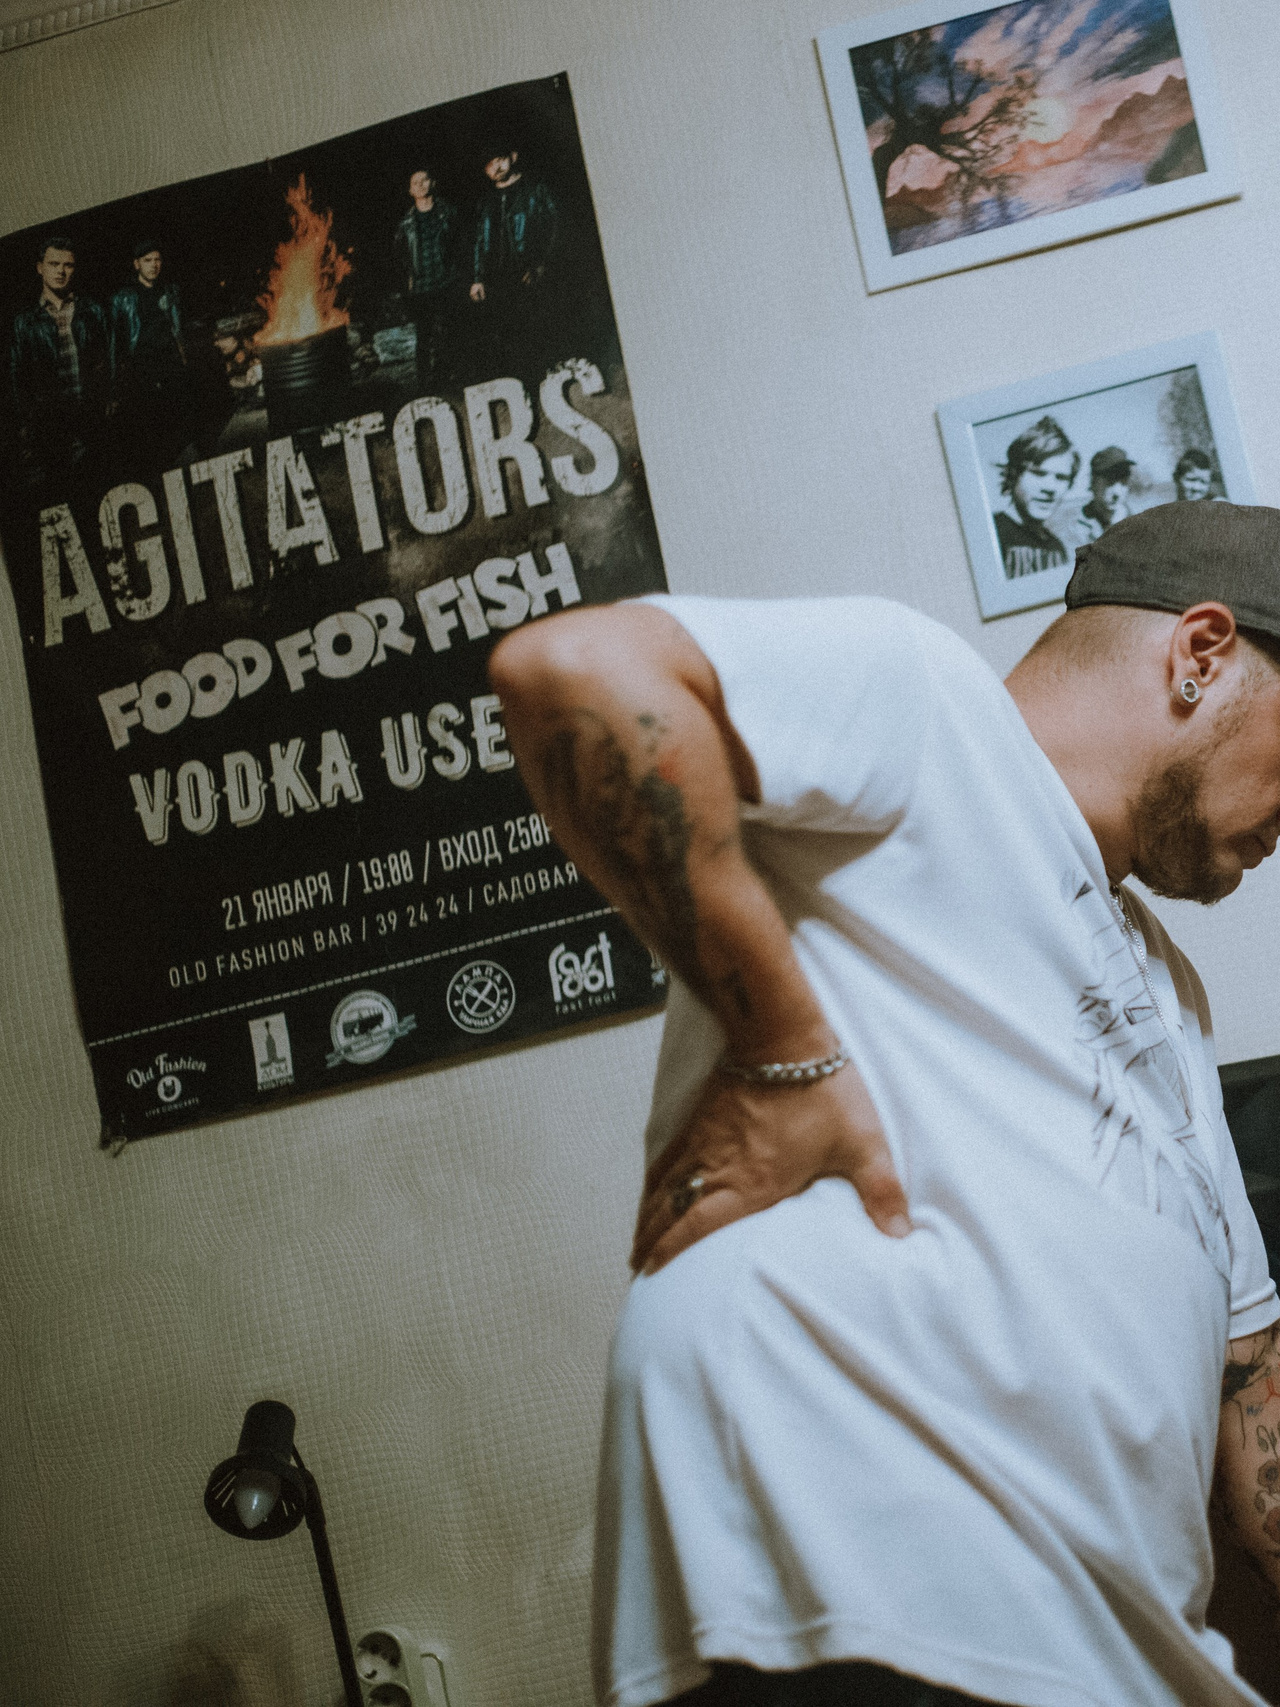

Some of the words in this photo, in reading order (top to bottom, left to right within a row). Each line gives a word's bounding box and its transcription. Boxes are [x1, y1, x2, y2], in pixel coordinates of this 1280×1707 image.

[39, 357, 620, 648] AGITATORS
[99, 638, 272, 750] FOOD
[275, 598, 415, 692] FOR
[416, 542, 582, 653] FISH
[130, 729, 364, 845] VODKA
[169, 960, 207, 988] OLD
[216, 936, 305, 976] FASHION
[313, 923, 352, 952] BAR
[376, 909, 398, 936] 39
[406, 902, 429, 928] 24
[436, 893, 459, 920] 24
[483, 860, 579, 907] САДОВАЯ
[222, 895, 248, 930] 21
[252, 871, 333, 923] ЯНВАРЯ
[358, 849, 414, 894] 19:00
[438, 825, 503, 872] ВХОД
[126, 1066, 155, 1089] Old
[154, 1052, 207, 1075] Fashion
